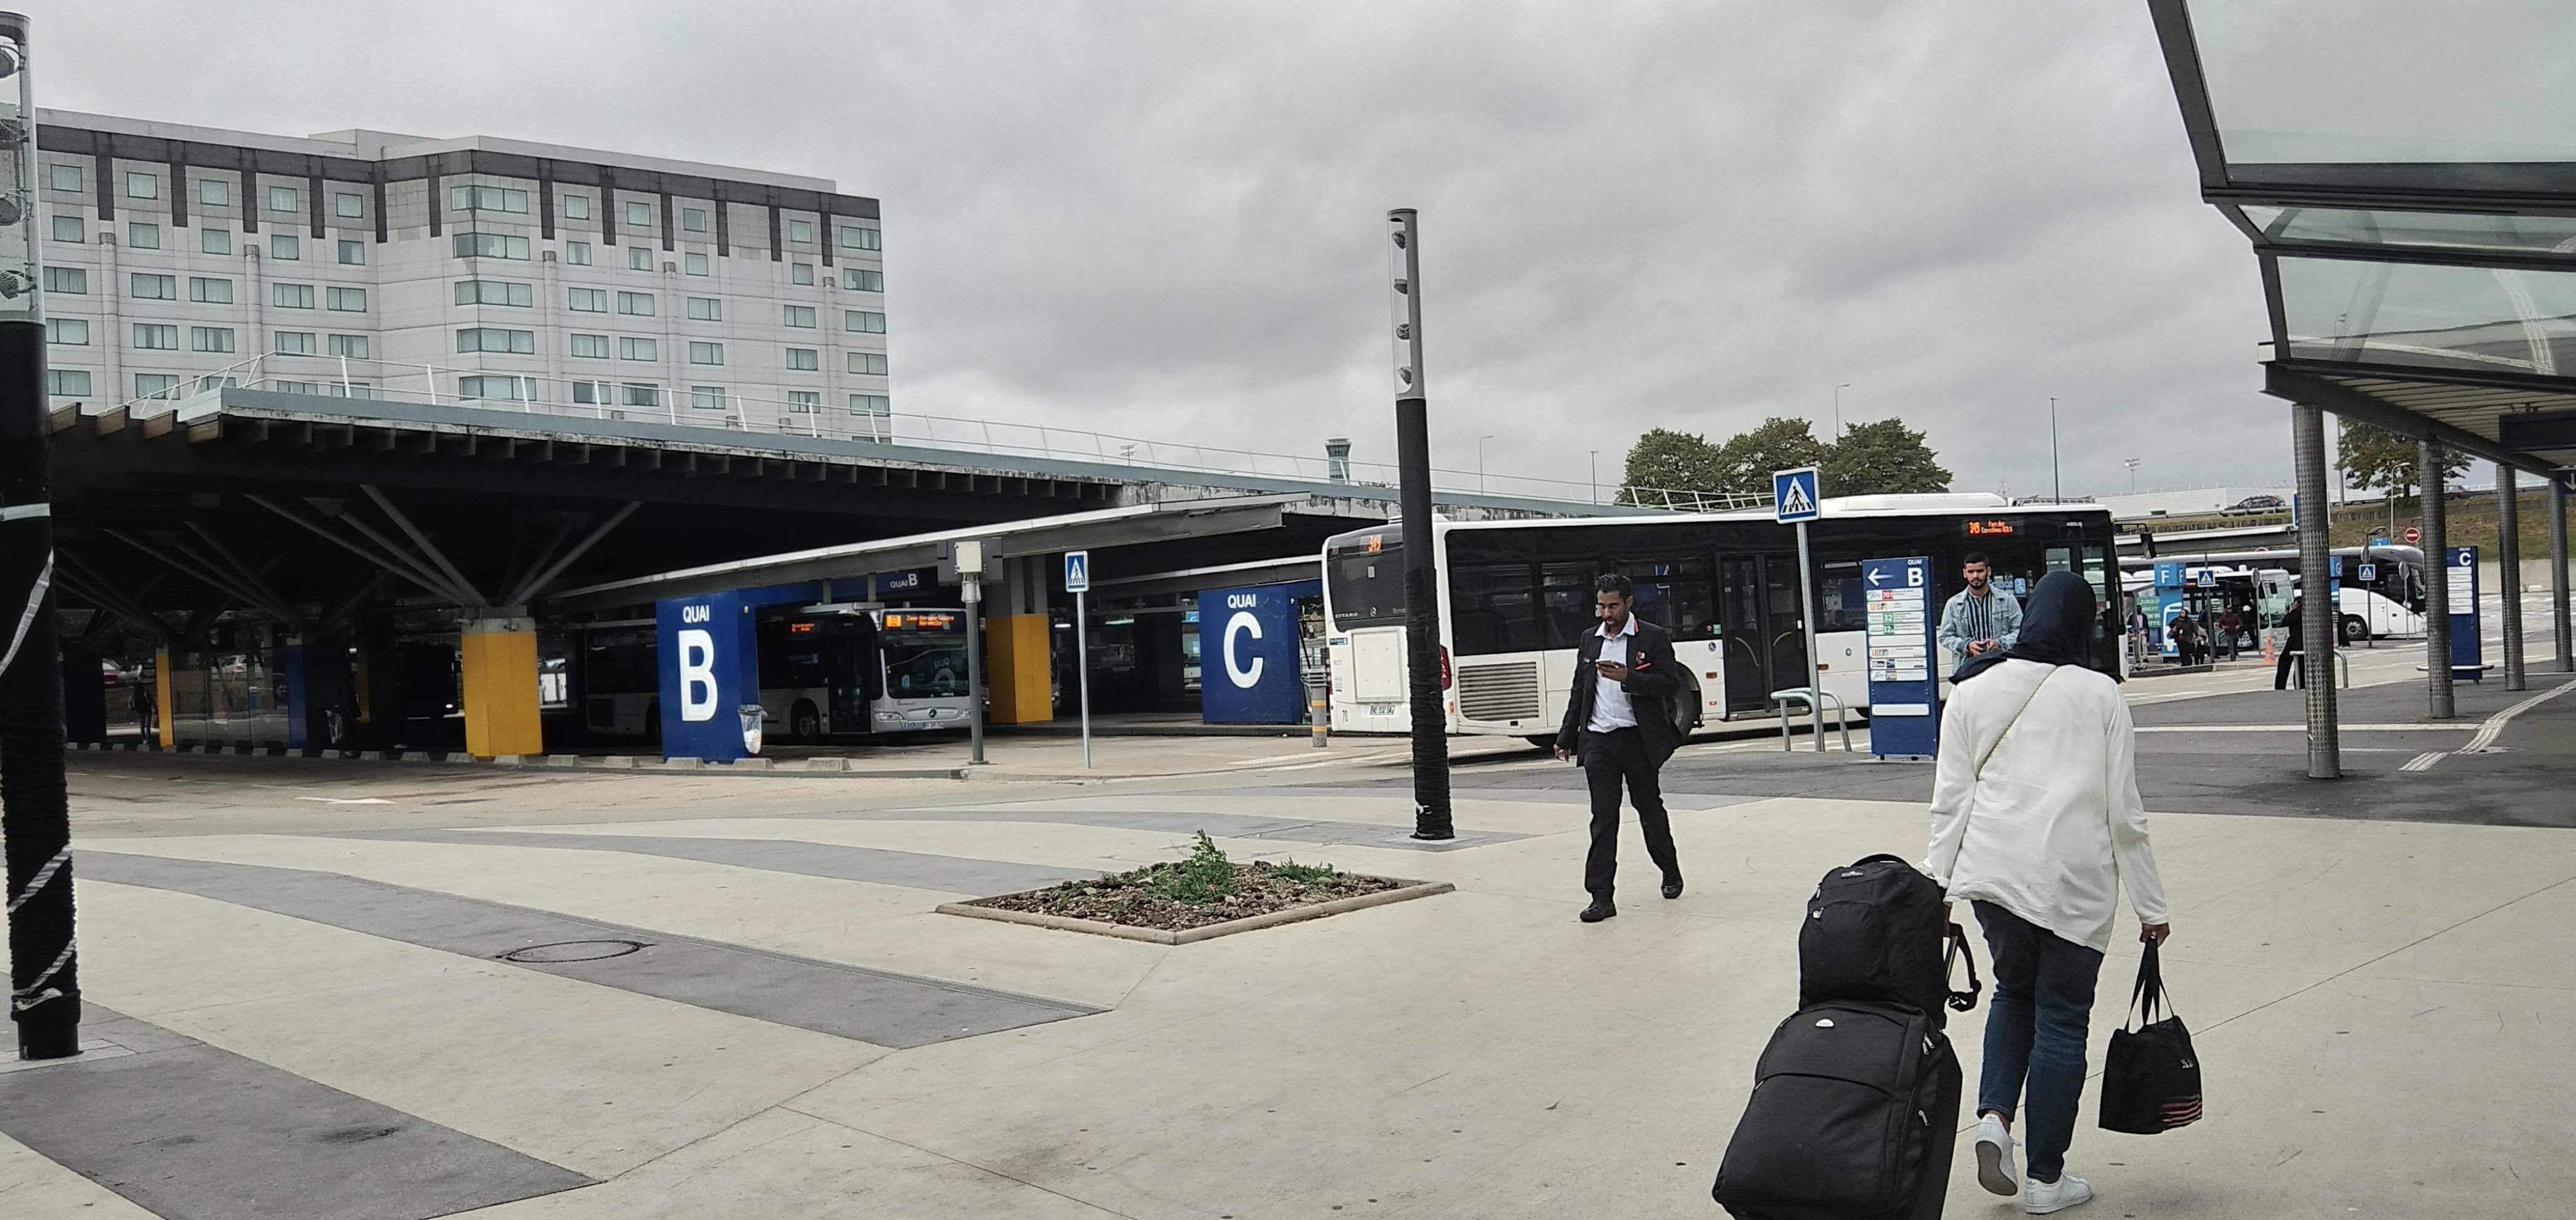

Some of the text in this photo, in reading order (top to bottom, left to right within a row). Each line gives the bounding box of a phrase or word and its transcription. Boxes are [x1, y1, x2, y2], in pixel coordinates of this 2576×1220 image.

[2459, 552, 2471, 566] C
[890, 573, 918, 588] QUAI B
[1907, 567, 1924, 587] B
[2161, 570, 2169, 584] F
[1228, 594, 1257, 609] QUAI
[683, 604, 710, 624] QUAI
[1884, 614, 1893, 622] 32
[1223, 611, 1263, 688] C
[679, 629, 718, 722] B
[1342, 710, 1348, 722] 70
